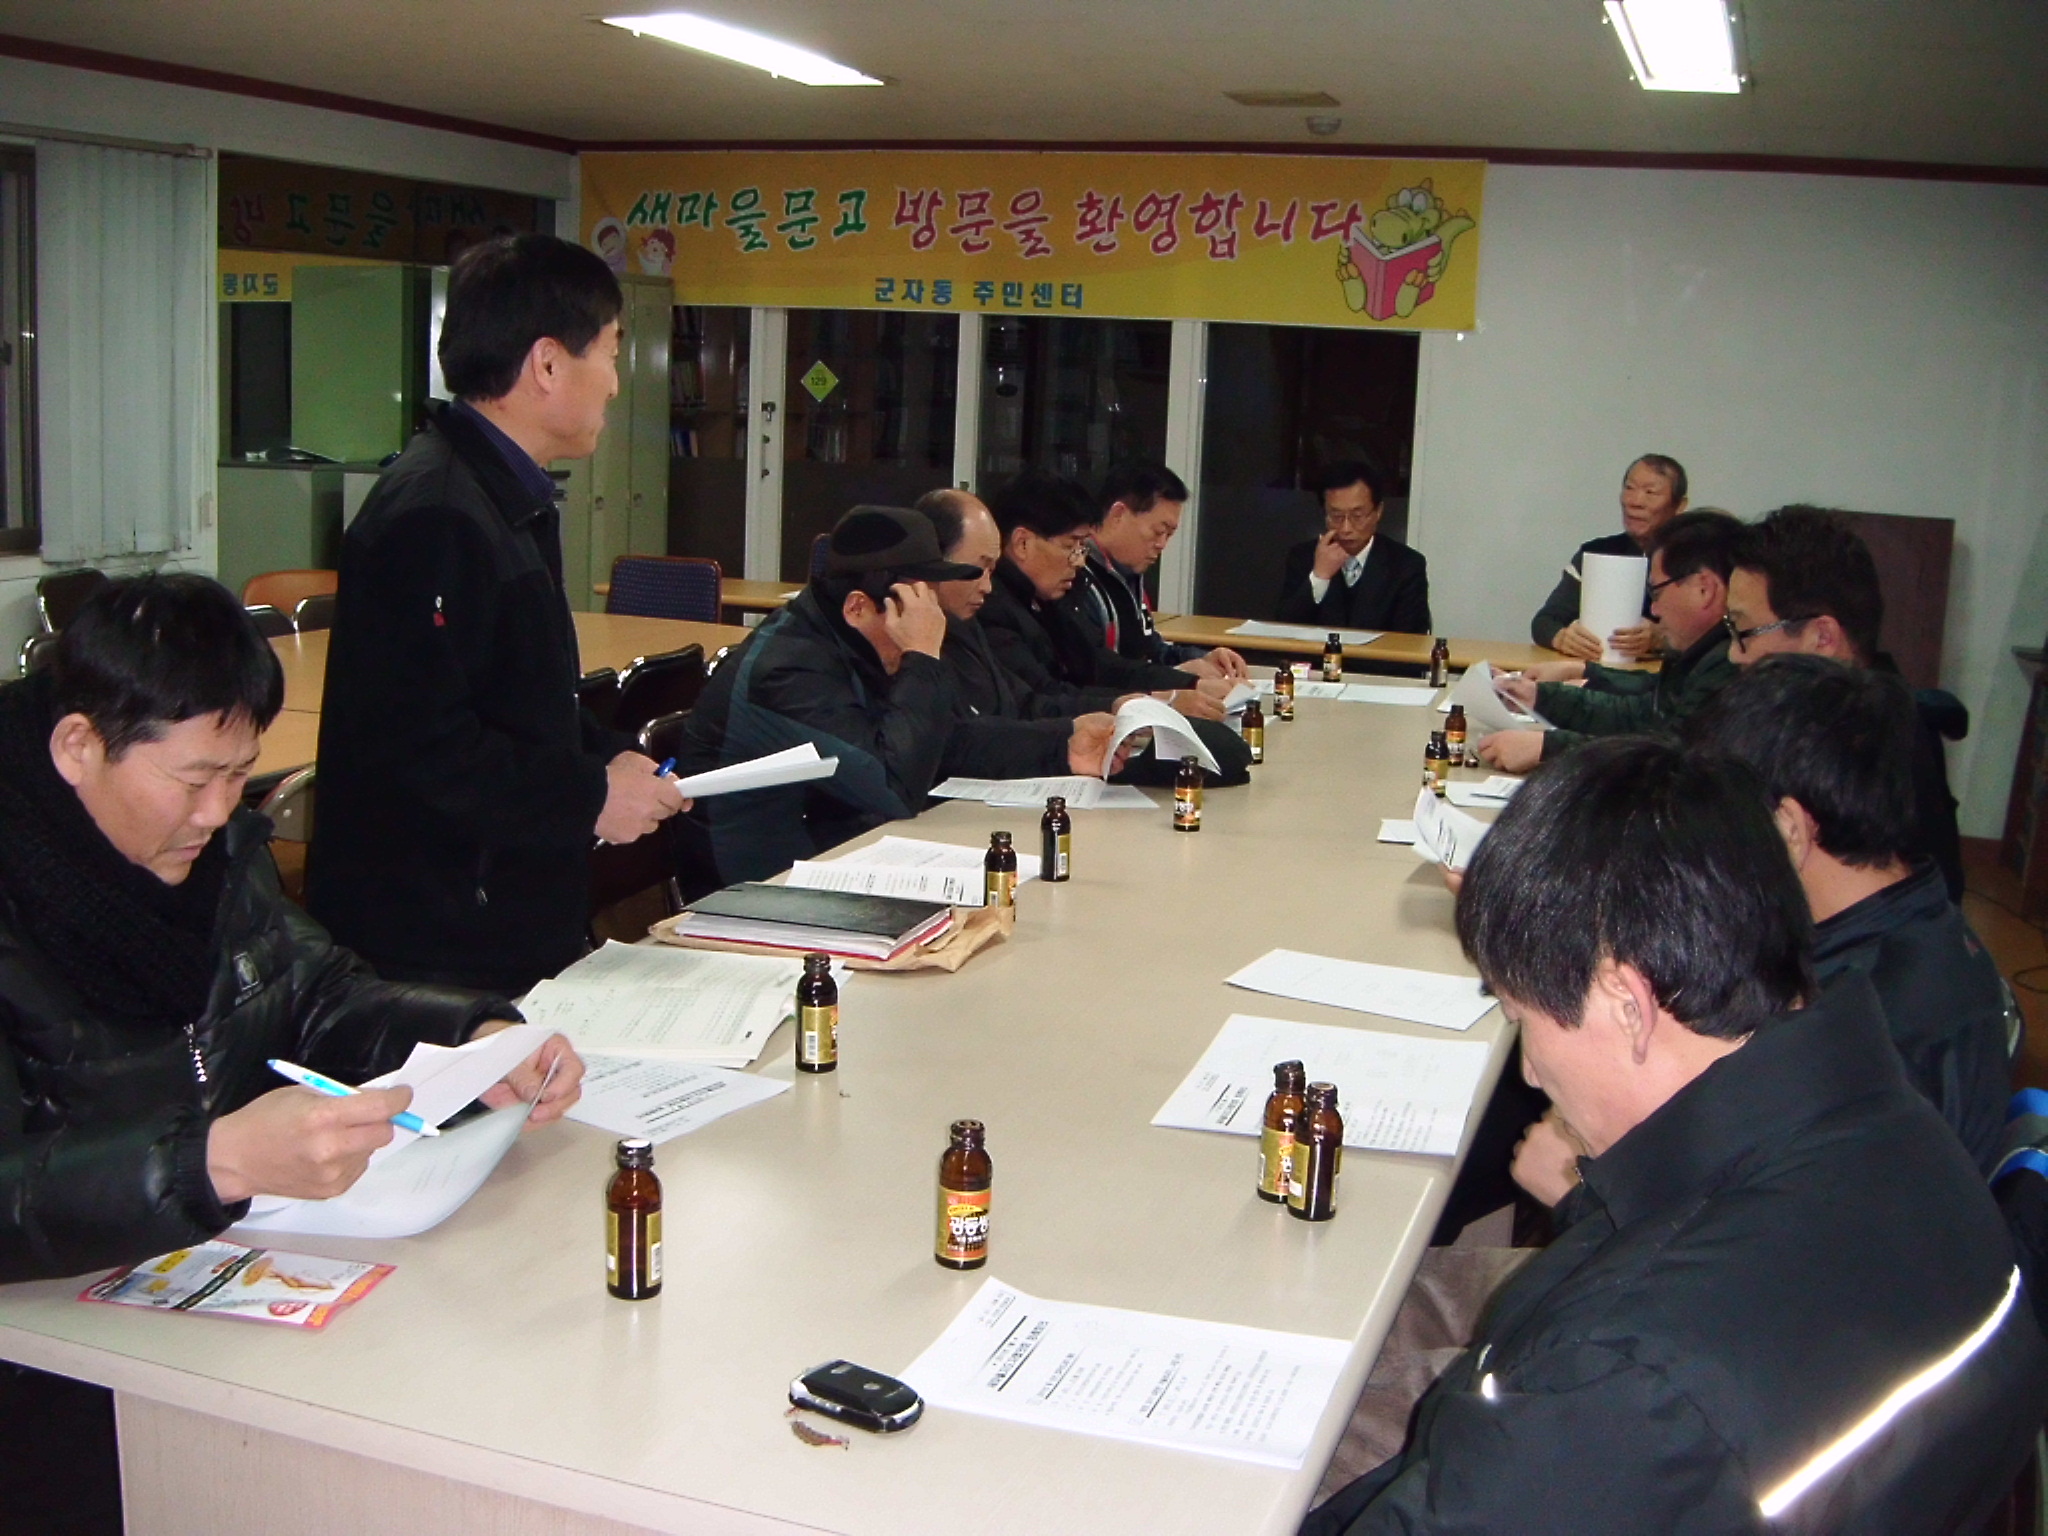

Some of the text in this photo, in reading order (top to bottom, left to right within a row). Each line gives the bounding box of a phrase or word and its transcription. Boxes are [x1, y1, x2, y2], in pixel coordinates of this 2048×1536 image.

[625, 187, 1362, 259] 새마을문고 방문을 환영합니다
[875, 277, 1084, 309] 군자동 주민센터
